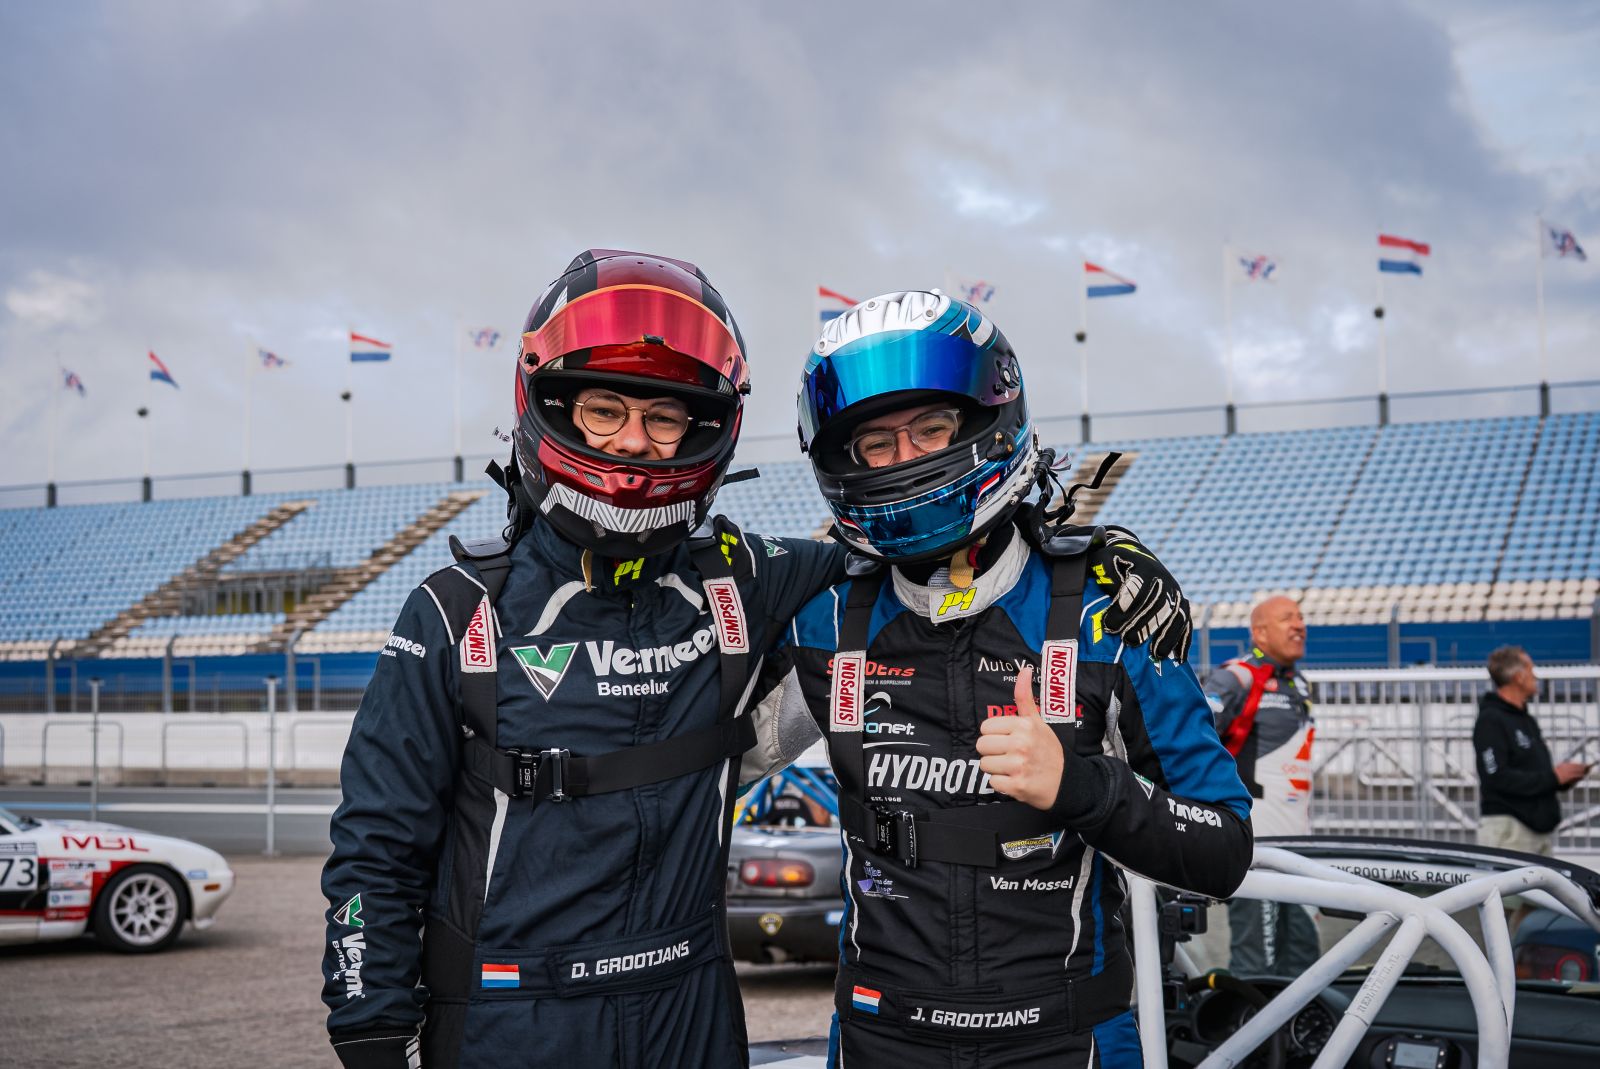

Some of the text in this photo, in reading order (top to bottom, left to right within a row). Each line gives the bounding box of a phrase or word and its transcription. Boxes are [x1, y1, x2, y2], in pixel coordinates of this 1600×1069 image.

[714, 586, 741, 645] SIMPSON
[585, 624, 717, 677] Vermee
[597, 679, 669, 697] Benelux
[838, 661, 857, 722] SIMPSON
[1049, 650, 1067, 713] SIMPSON
[867, 753, 1008, 796] HYDROTE
[0, 858, 35, 886] 73
[990, 875, 1074, 891] Van Mossel
[571, 940, 690, 979] D. GROOTJANS
[910, 1007, 1041, 1028] J. GROOTJANS
